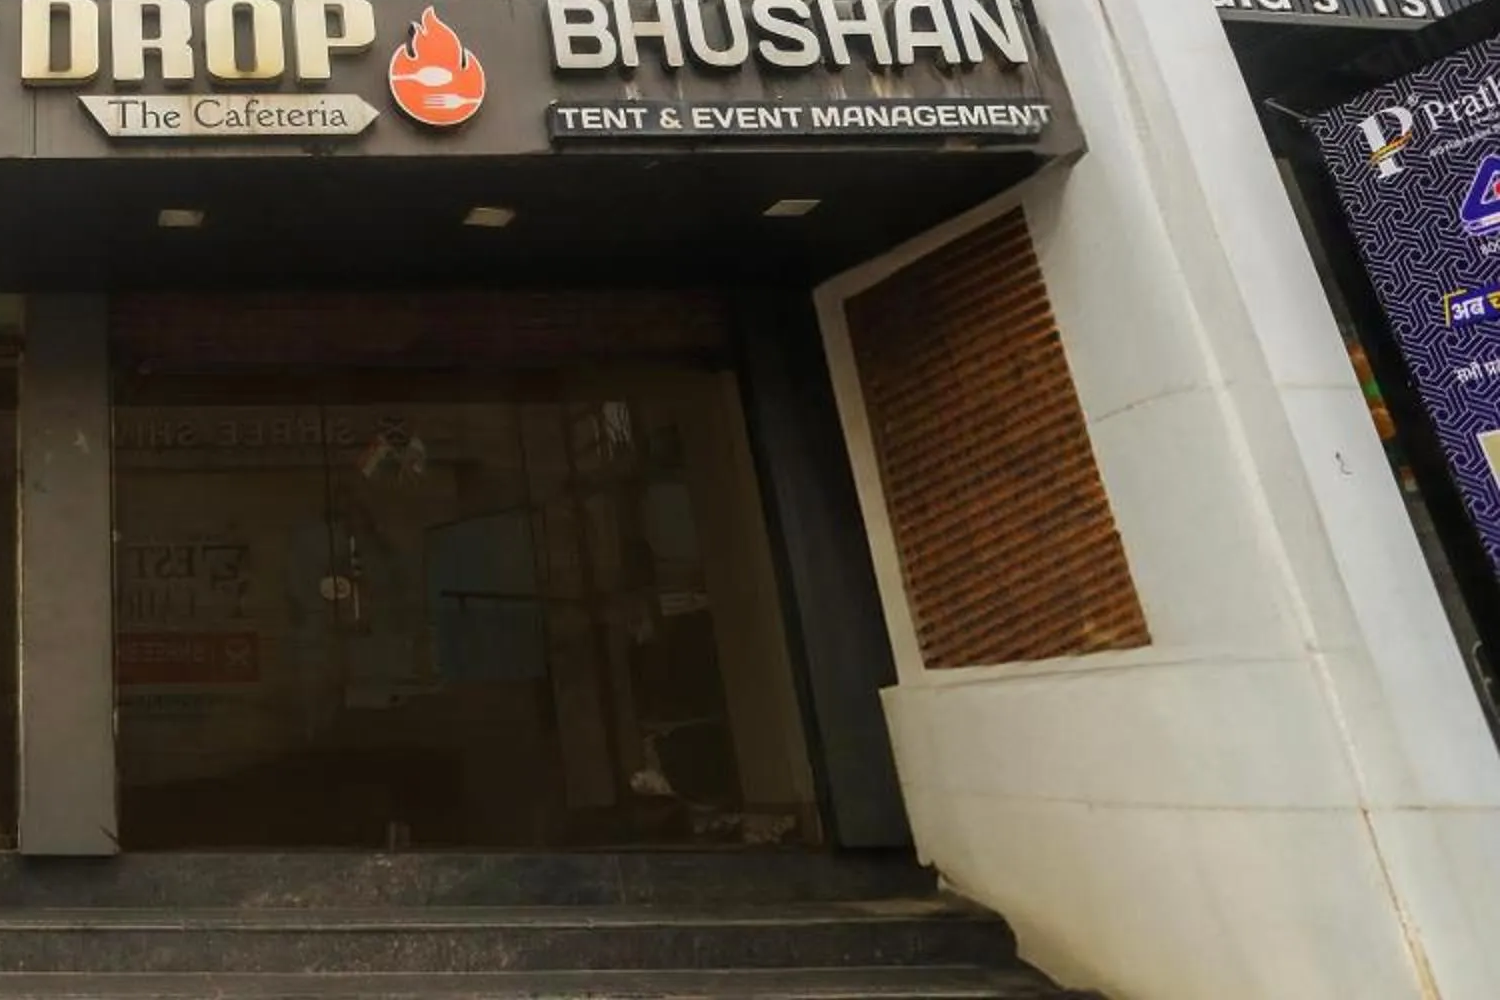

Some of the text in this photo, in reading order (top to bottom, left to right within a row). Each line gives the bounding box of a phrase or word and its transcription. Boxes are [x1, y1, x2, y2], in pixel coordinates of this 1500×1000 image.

[108, 98, 348, 130] The Cafeteria
[558, 104, 1051, 129] TENT & EVENT MANAGEMENT
